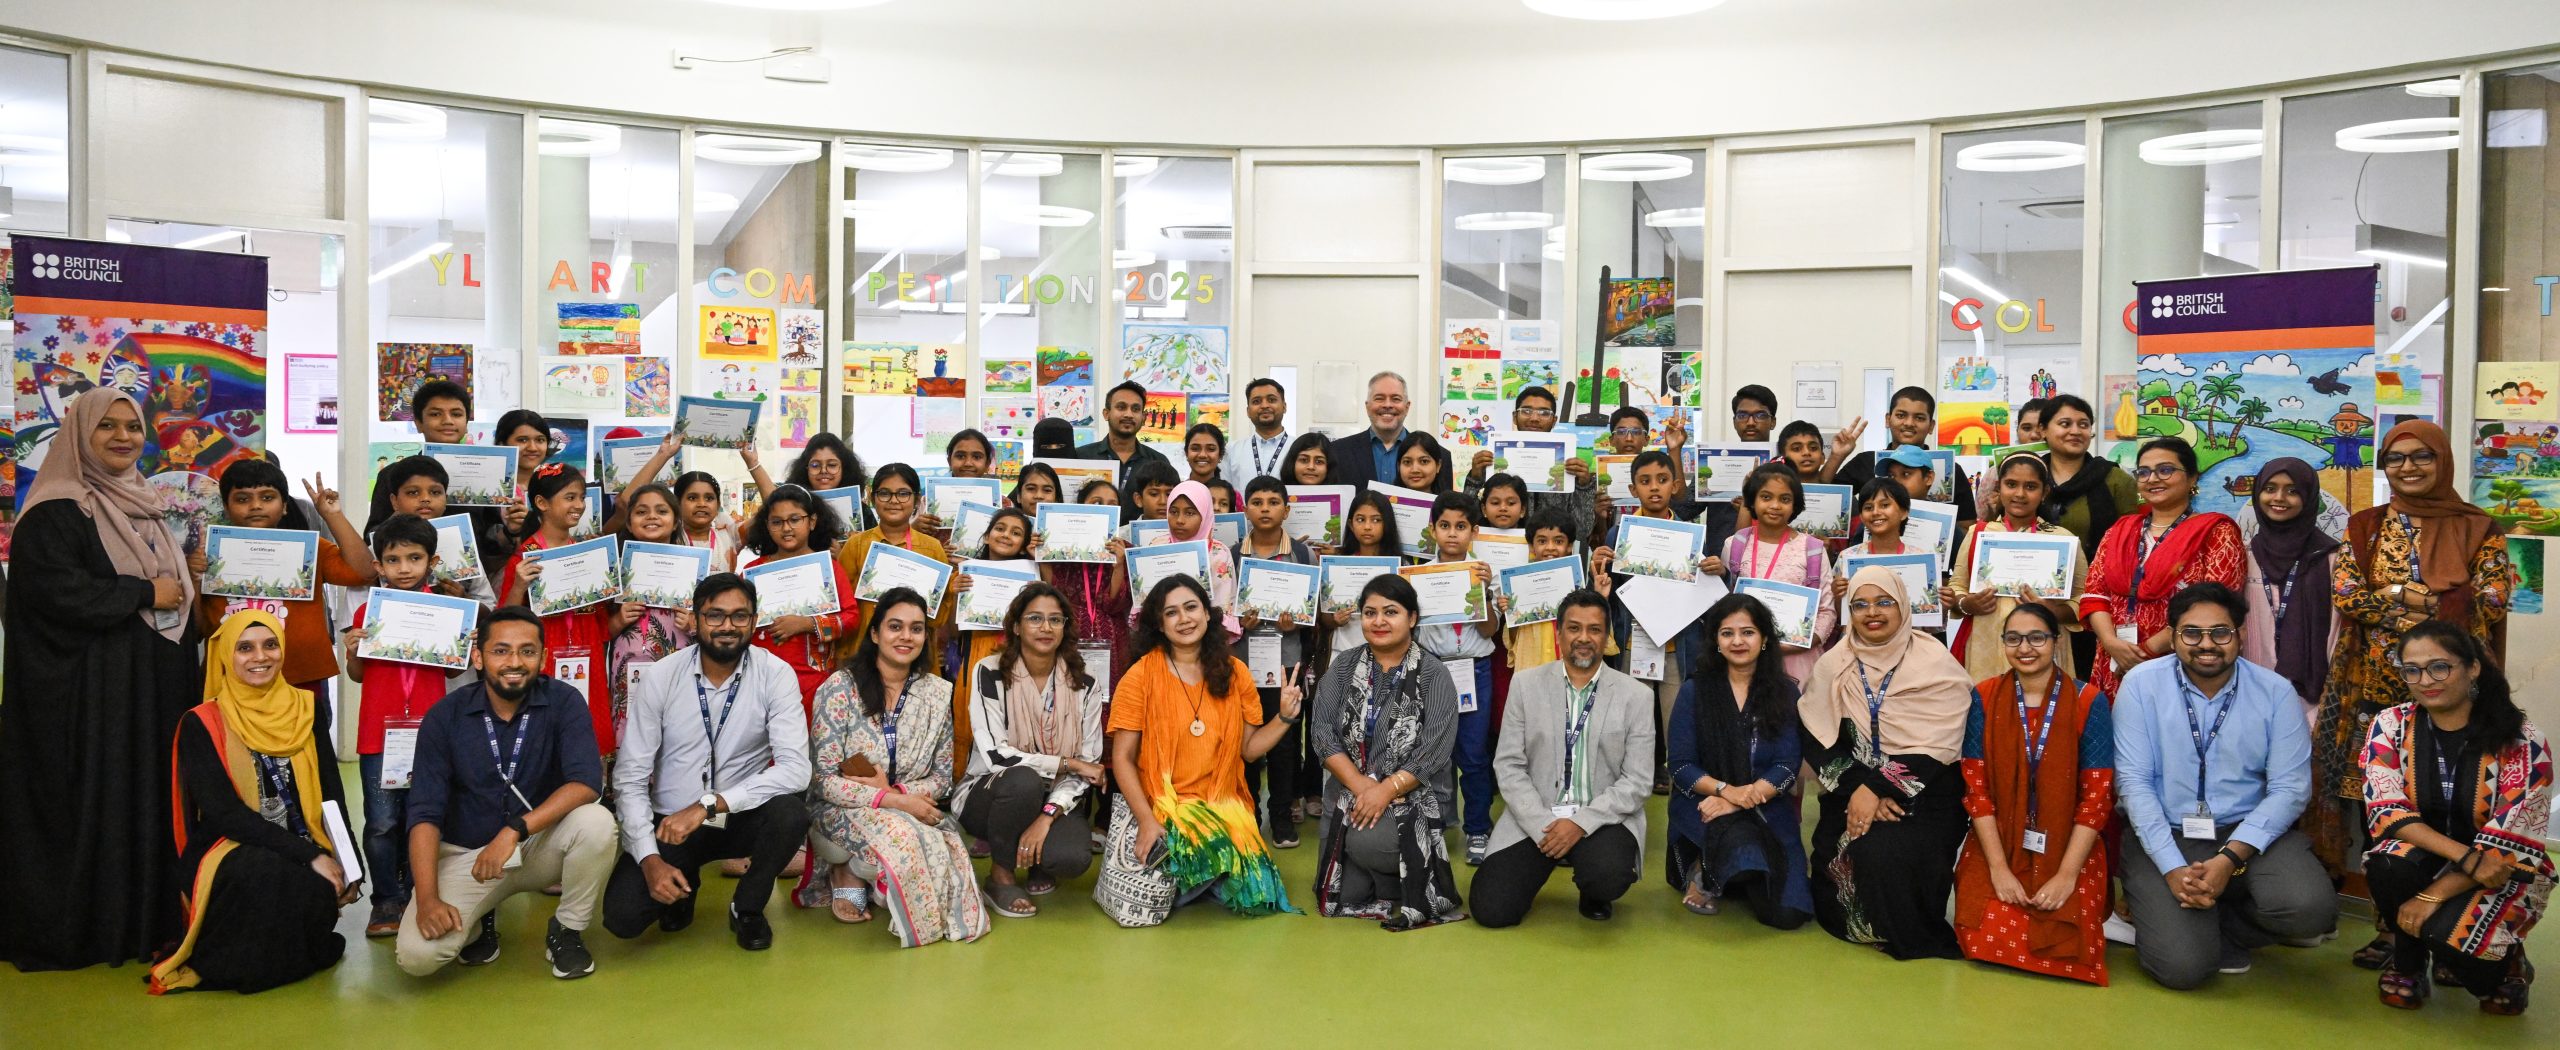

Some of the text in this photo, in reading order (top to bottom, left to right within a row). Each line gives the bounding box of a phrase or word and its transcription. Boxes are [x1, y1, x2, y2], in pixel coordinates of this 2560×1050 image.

[64, 256, 120, 271] BRITISH
[63, 268, 123, 283] COUNCIL
[429, 253, 481, 287] YL
[548, 260, 649, 293] ART
[1126, 271, 1214, 304] 2025
[2176, 292, 2223, 306] BRITISH
[2176, 303, 2227, 316] COUNCIL
[564, 560, 584, 568] Certificate
